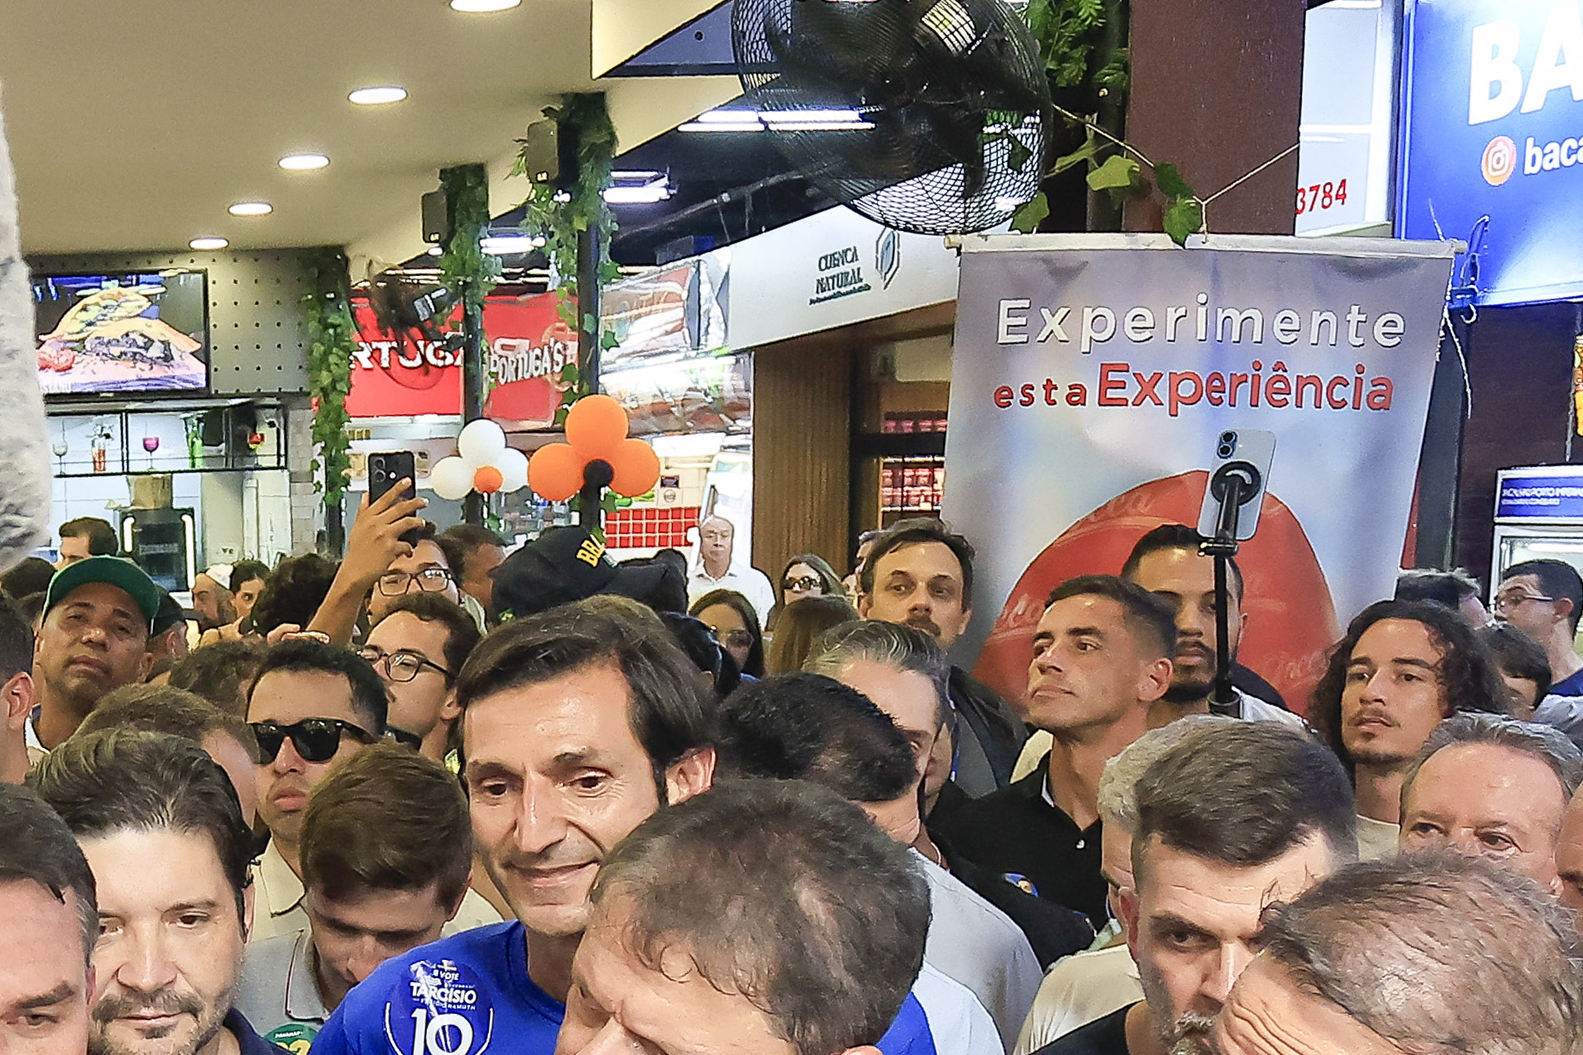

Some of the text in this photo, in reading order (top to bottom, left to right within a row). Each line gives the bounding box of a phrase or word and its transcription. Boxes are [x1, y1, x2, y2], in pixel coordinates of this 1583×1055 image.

[1523, 136, 1583, 176] bac
[818, 246, 860, 272] CUENCA
[815, 267, 864, 295] NATURAL
[996, 292, 1406, 354] Experimente
[993, 360, 1395, 417] esta Experiência
[439, 971, 460, 981] VOTE
